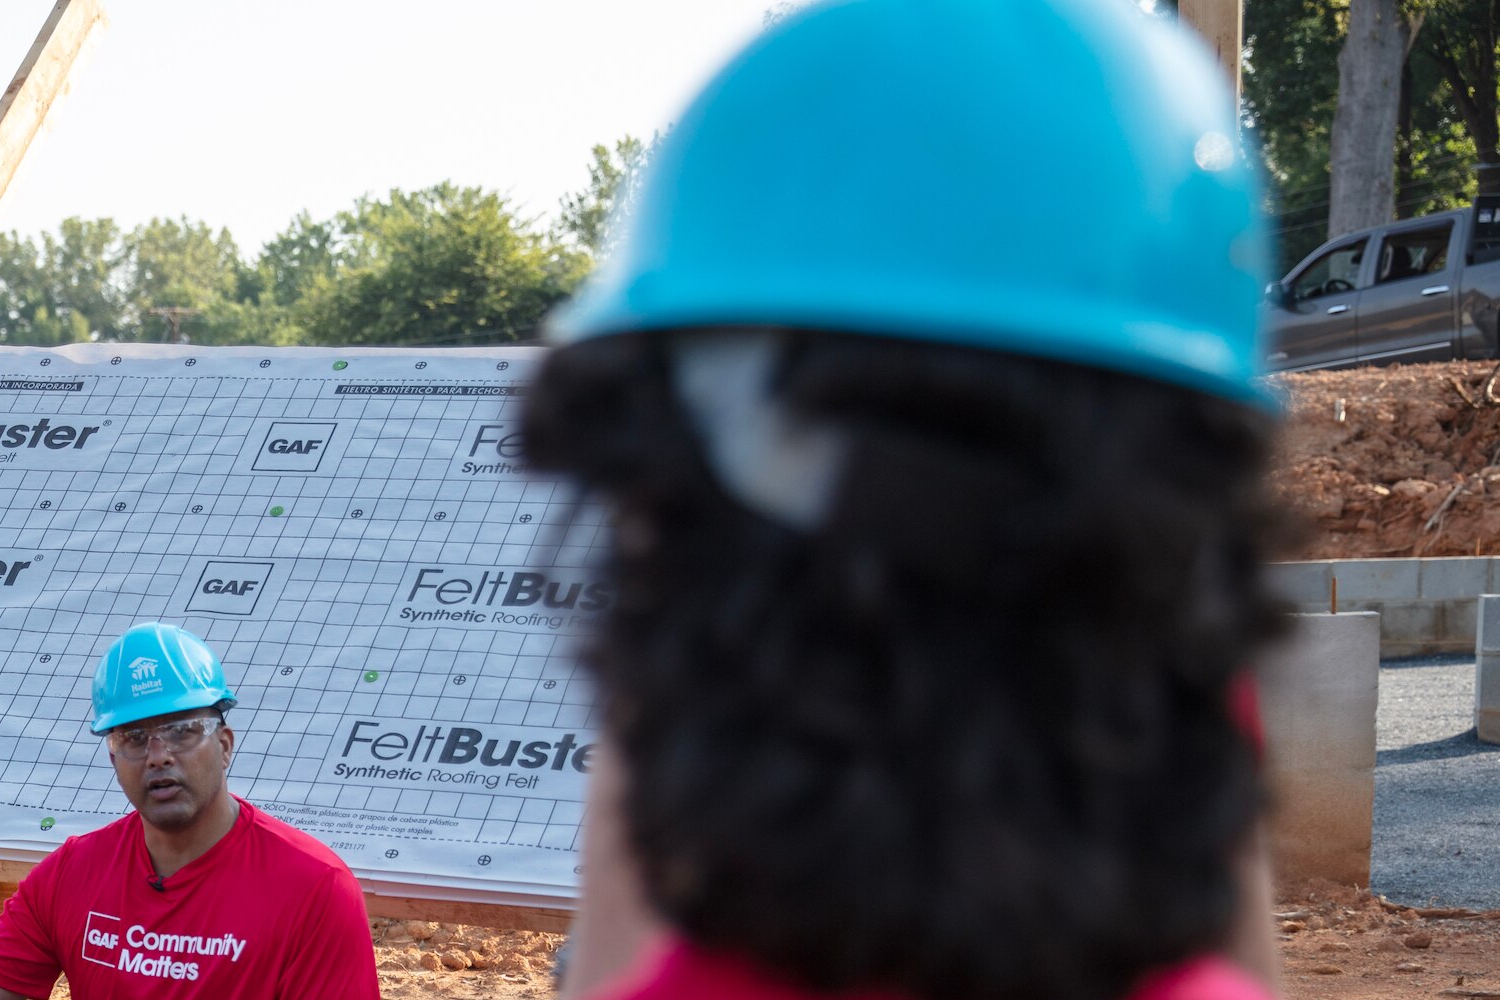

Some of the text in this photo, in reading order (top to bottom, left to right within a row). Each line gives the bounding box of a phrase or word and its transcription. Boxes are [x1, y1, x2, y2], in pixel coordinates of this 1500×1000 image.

[11, 381, 78, 391] INCORPORADA
[340, 386, 379, 394] FIELTRO
[436, 386, 462, 395] PARA
[268, 438, 323, 455] GAF
[202, 578, 259, 596] GAF
[399, 607, 487, 624] Synthetic
[490, 611, 564, 630] Roofing
[131, 679, 162, 693] Habitat
[333, 763, 541, 790] Synthetic Roofing Felt
[294, 818, 319, 826] plastic
[320, 819, 334, 828] cap
[336, 820, 353, 829] nails
[364, 823, 390, 832] plastic
[407, 826, 433, 836] staples
[359, 813, 386, 822] grapas
[387, 814, 398, 822] de
[399, 816, 428, 824] cabeza
[87, 924, 247, 962] GAF Community
[117, 948, 200, 981] Matters
